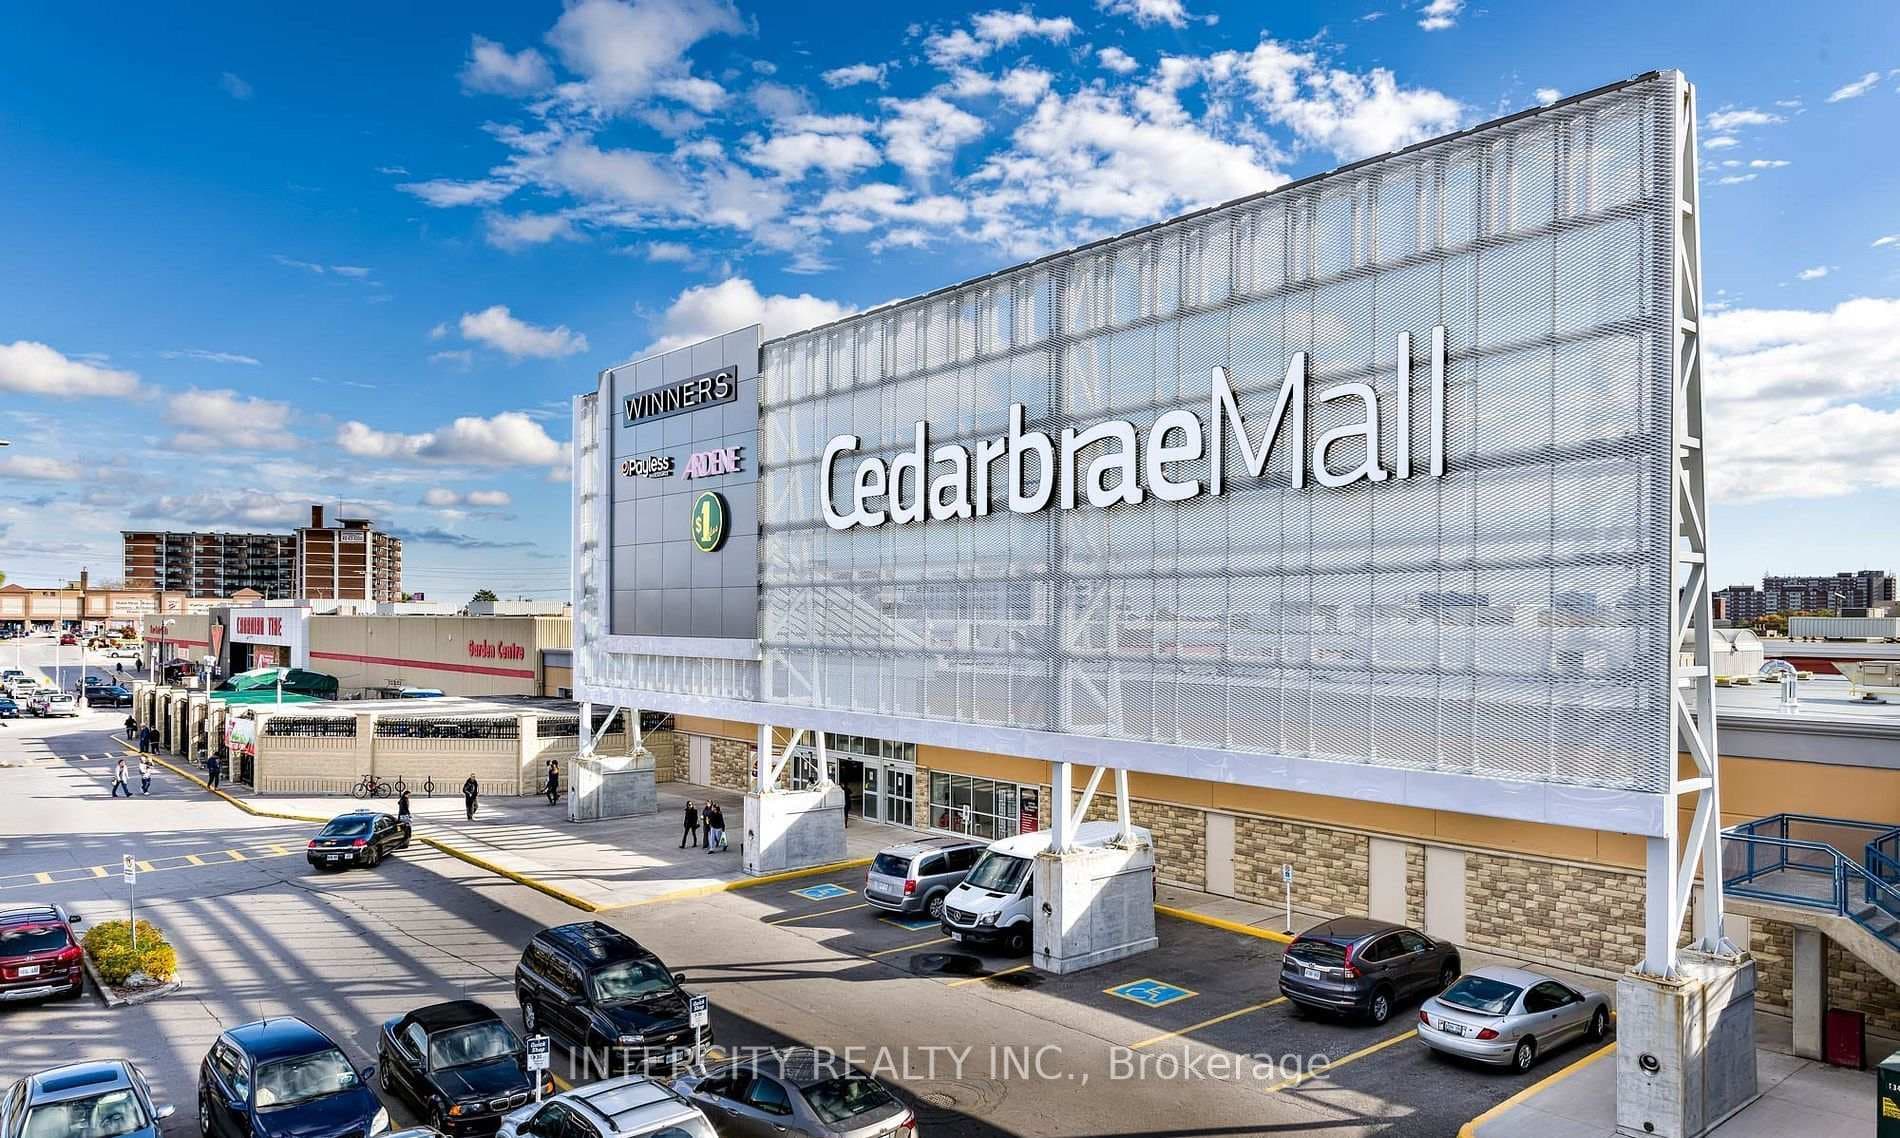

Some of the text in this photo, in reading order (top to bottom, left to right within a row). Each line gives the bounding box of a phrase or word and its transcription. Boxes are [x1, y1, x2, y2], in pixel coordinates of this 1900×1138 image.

[624, 372, 729, 420] WINNERS
[629, 456, 669, 477] Payless
[681, 446, 740, 480] ARDENE
[237, 617, 282, 636] CANADIAN TIRE
[469, 640, 525, 660] Garden Centre
